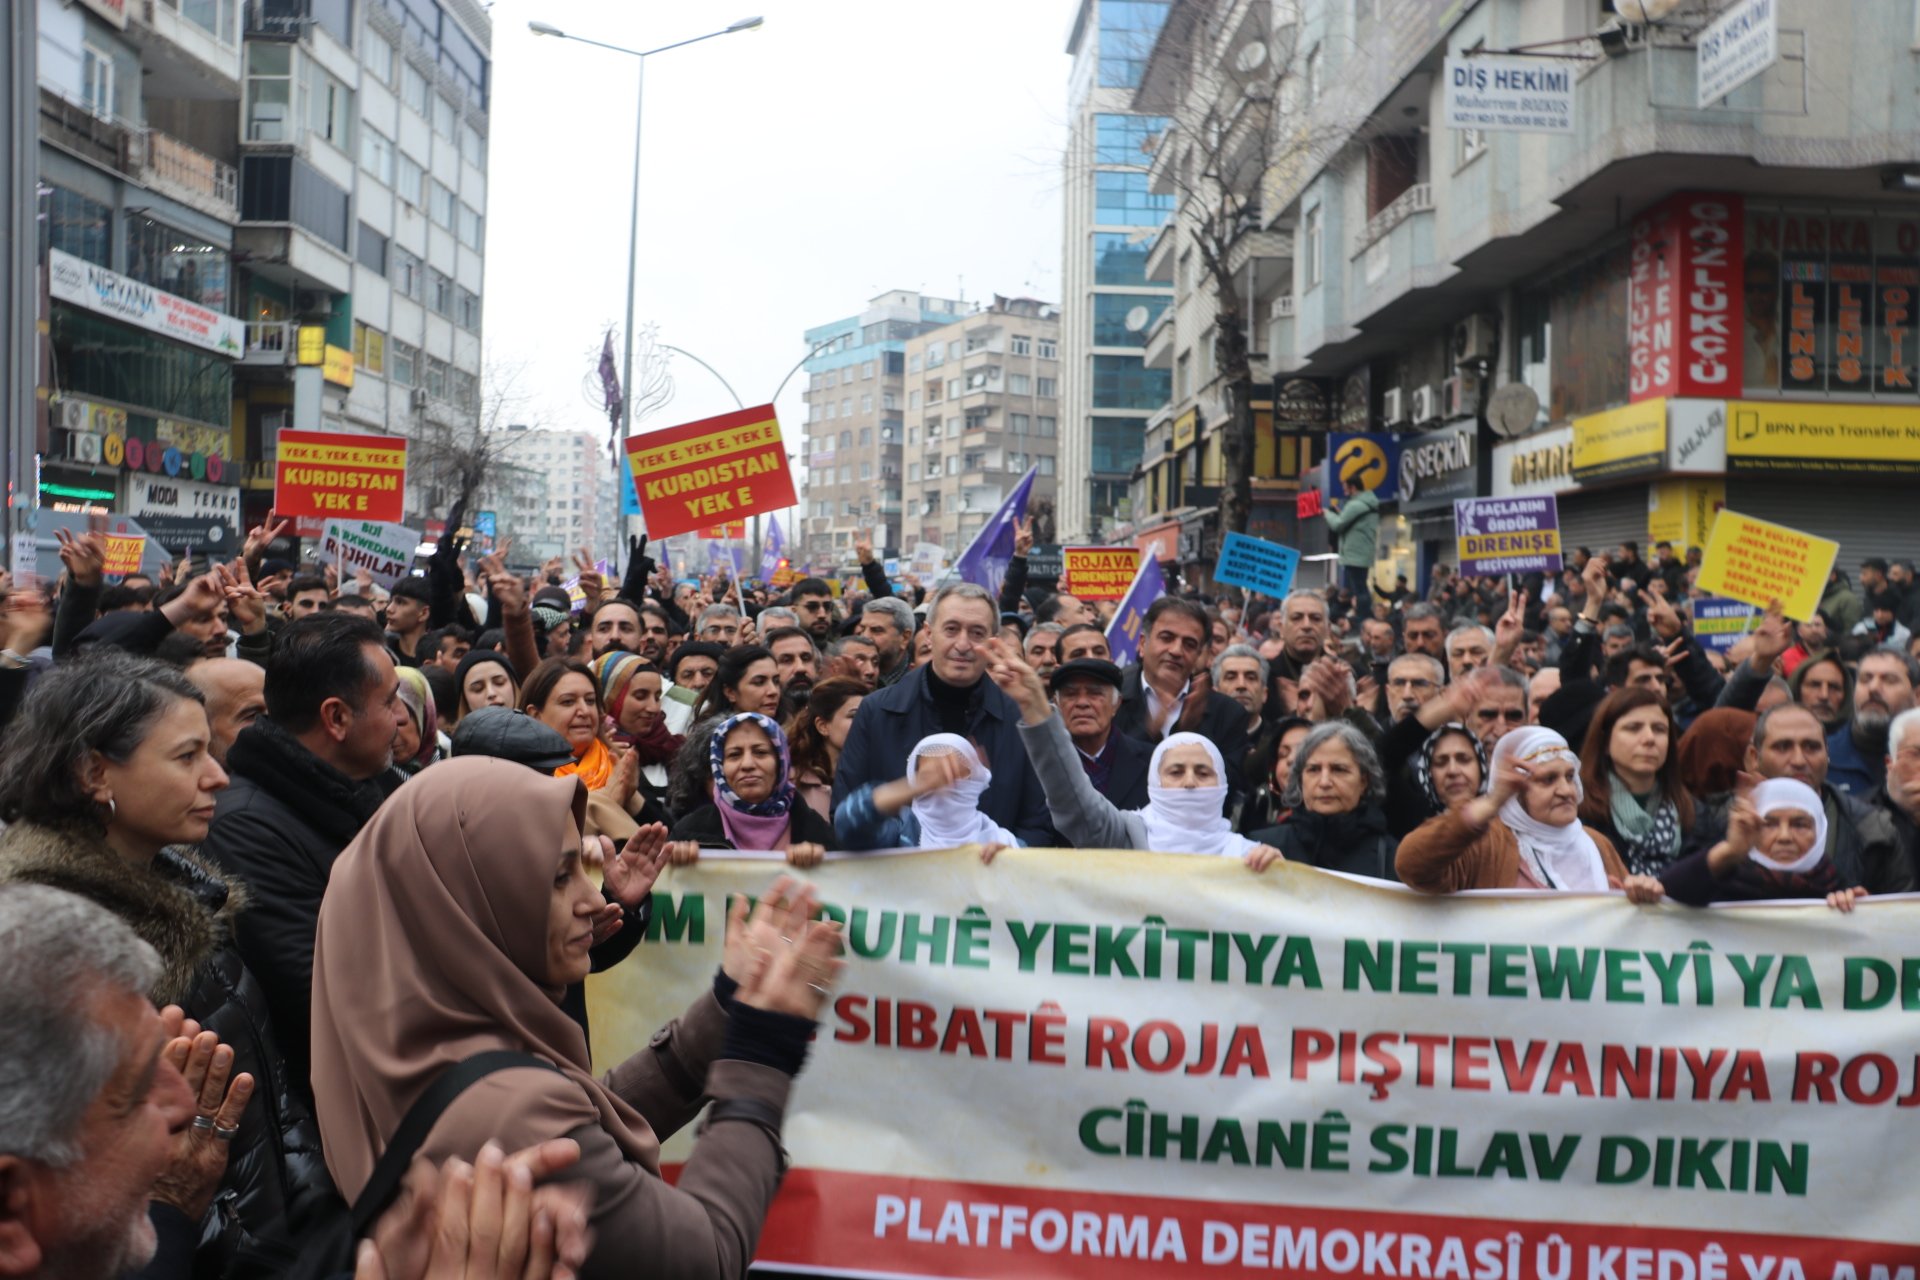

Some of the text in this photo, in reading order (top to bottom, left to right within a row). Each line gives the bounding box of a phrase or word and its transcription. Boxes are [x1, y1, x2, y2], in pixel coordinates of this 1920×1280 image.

[1454, 67, 1569, 93] DİŞ HEKİMİ
[1690, 202, 1729, 384] GÖZLÜKÇÜ
[1789, 282, 1815, 381] LENS
[1837, 285, 1863, 383] LENS
[1766, 422, 1795, 435] BPN
[1800, 423, 1835, 437] Para
[1840, 424, 1901, 438] Transfer
[285, 447, 307, 458] YEK
[327, 450, 348, 460] YEK
[367, 453, 389, 464] YEK
[392, 455, 399, 464] E
[637, 453, 666, 469] YEK
[684, 441, 713, 457] YEK
[732, 430, 761, 446] YEK
[764, 426, 774, 438] E
[1417, 430, 1471, 480] SEÇKİN
[284, 468, 398, 491] KURDISTAN
[645, 451, 780, 501] KURDISTAN
[147, 484, 179, 507] MODA
[194, 490, 237, 511] TEKNO
[312, 492, 368, 511] YEK E
[684, 486, 753, 518] YEK E
[1487, 515, 1538, 533] ÖRDÜM
[1742, 522, 1762, 535] HER
[1466, 533, 1554, 554] DİRENİŞE
[1069, 555, 1134, 569] ROJAVA
[1475, 556, 1547, 573] GEÇİYORUM!
[1763, 580, 1784, 594] APO
[1008, 914, 1323, 990] YEKÎTIYA
[1342, 939, 1715, 1007] NETEWEYÎ
[1726, 954, 1823, 1010] YA
[834, 995, 1068, 1065] SIBATÊ
[1086, 1017, 1270, 1080] ROJA
[1290, 1028, 1772, 1102] PIŞTEVANIYA
[1078, 1098, 1809, 1197] CÎHANÊ SILAV DIKIN
[874, 1194, 1187, 1264] PLATFORMA
[1201, 1220, 1523, 1280] DEMOKRASÎ
[1536, 1234, 1571, 1280] Û
